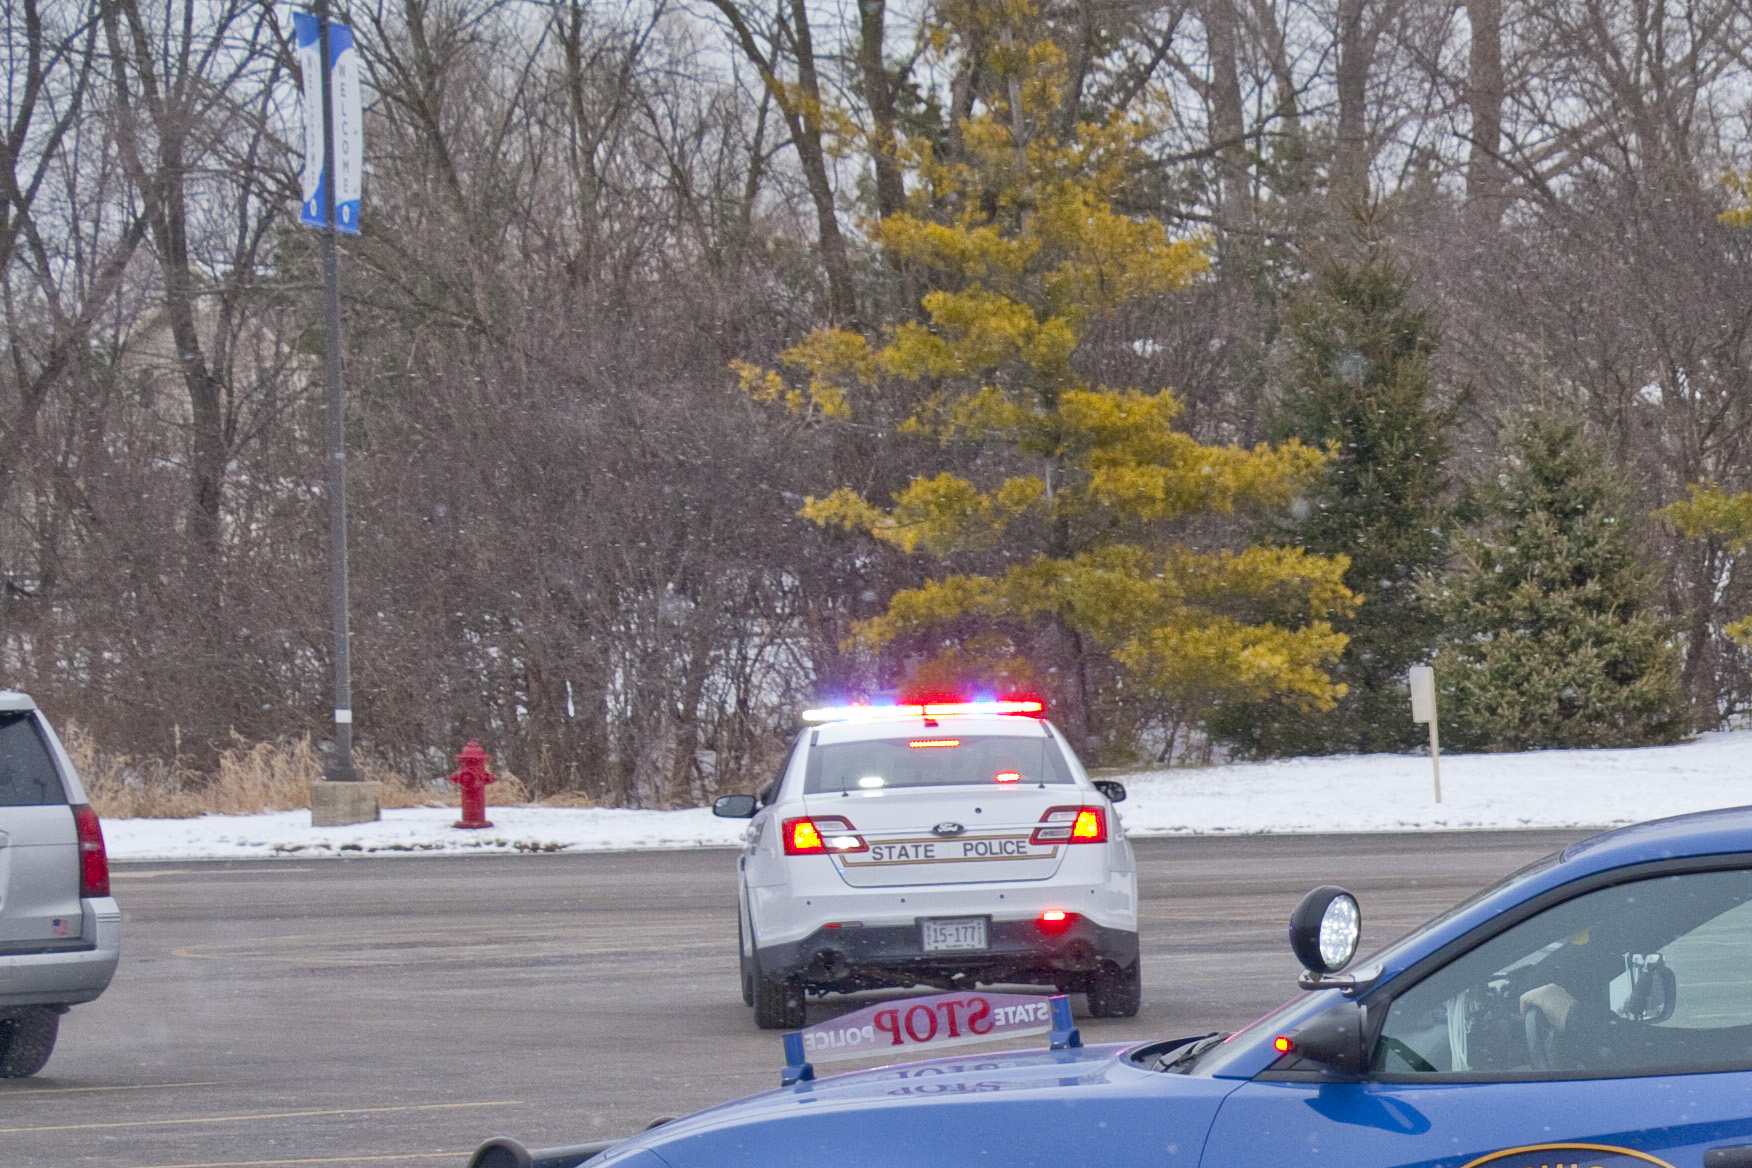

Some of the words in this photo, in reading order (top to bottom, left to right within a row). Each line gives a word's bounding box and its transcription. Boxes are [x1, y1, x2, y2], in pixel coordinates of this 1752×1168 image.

[338, 63, 350, 194] WELCOME
[937, 823, 959, 833] Ford
[872, 843, 935, 861] STATE
[963, 840, 1028, 857] POLICE
[933, 925, 976, 943] 15-177
